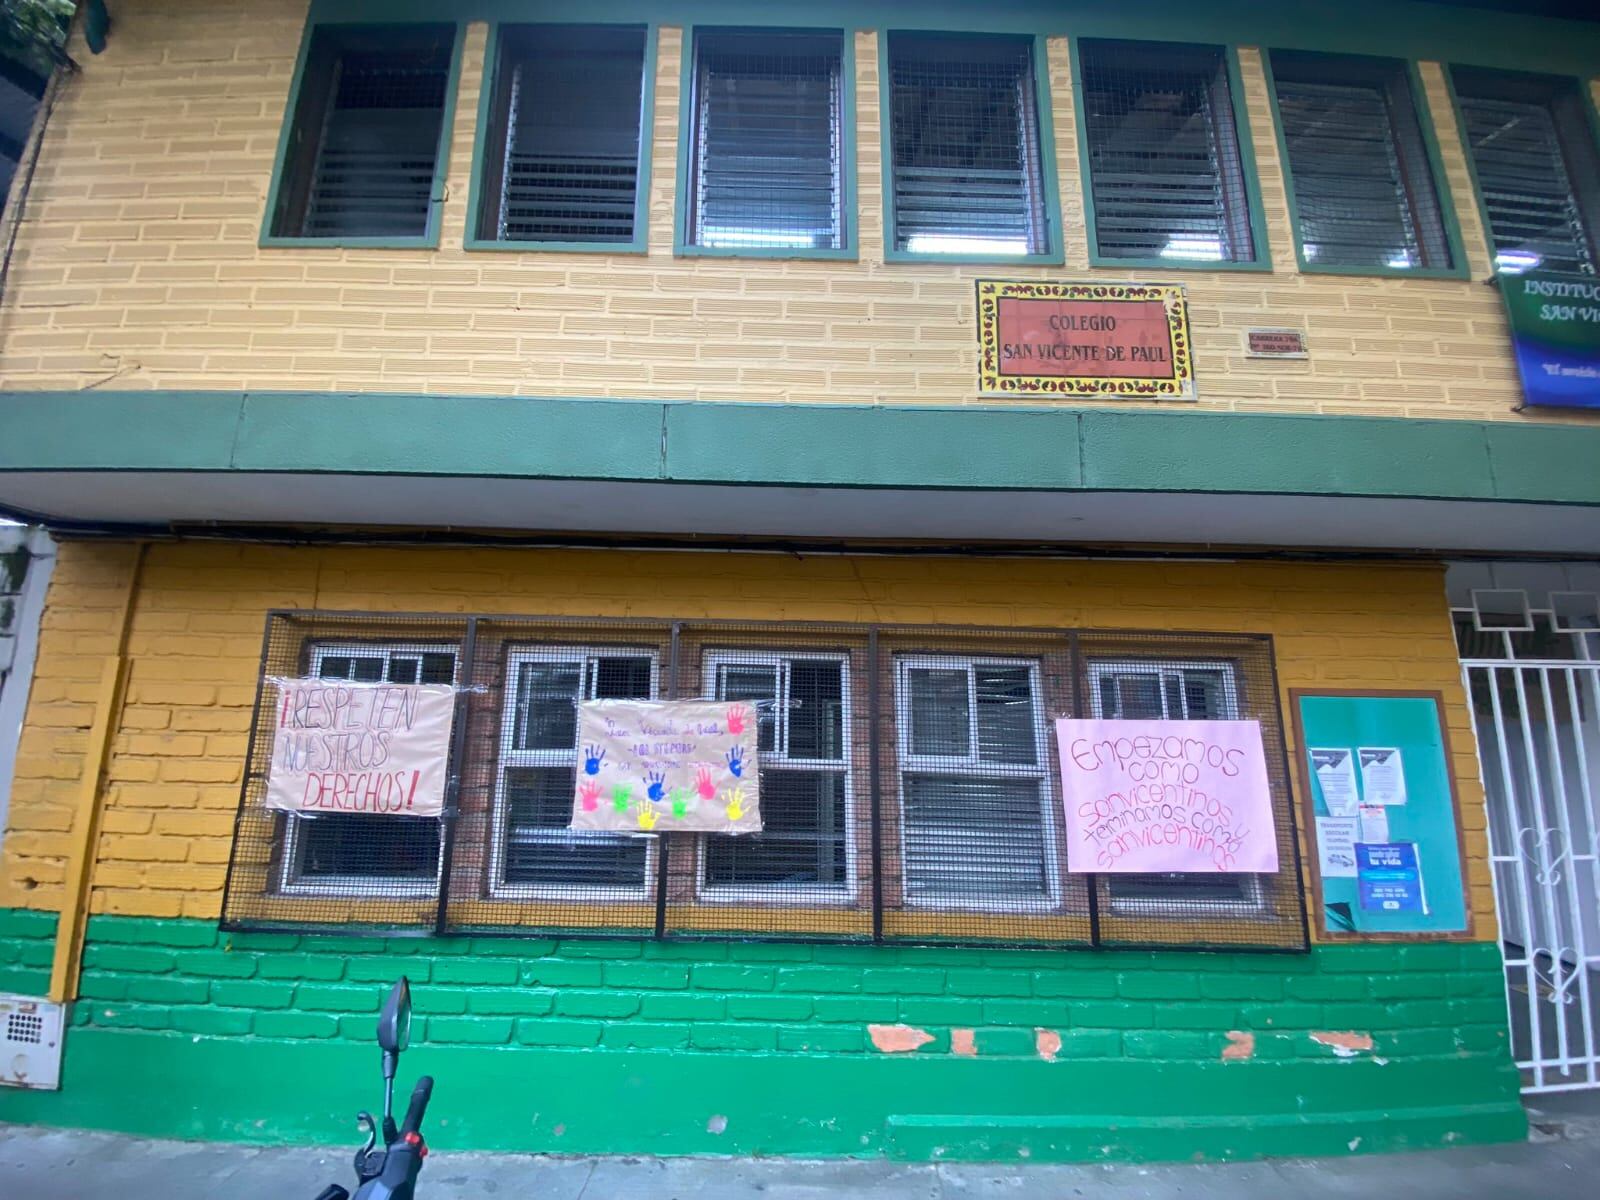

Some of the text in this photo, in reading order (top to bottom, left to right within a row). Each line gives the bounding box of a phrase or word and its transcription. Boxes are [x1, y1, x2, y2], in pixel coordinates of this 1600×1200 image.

[1050, 315, 1116, 331] COLEGIO
[1540, 305, 1600, 322] SAN VI
[1004, 344, 1167, 362] SAN VICENTE DE PAUL
[282, 731, 393, 771] NUESTROS
[1071, 736, 1245, 776] Empezamos
[1129, 760, 1199, 784] como
